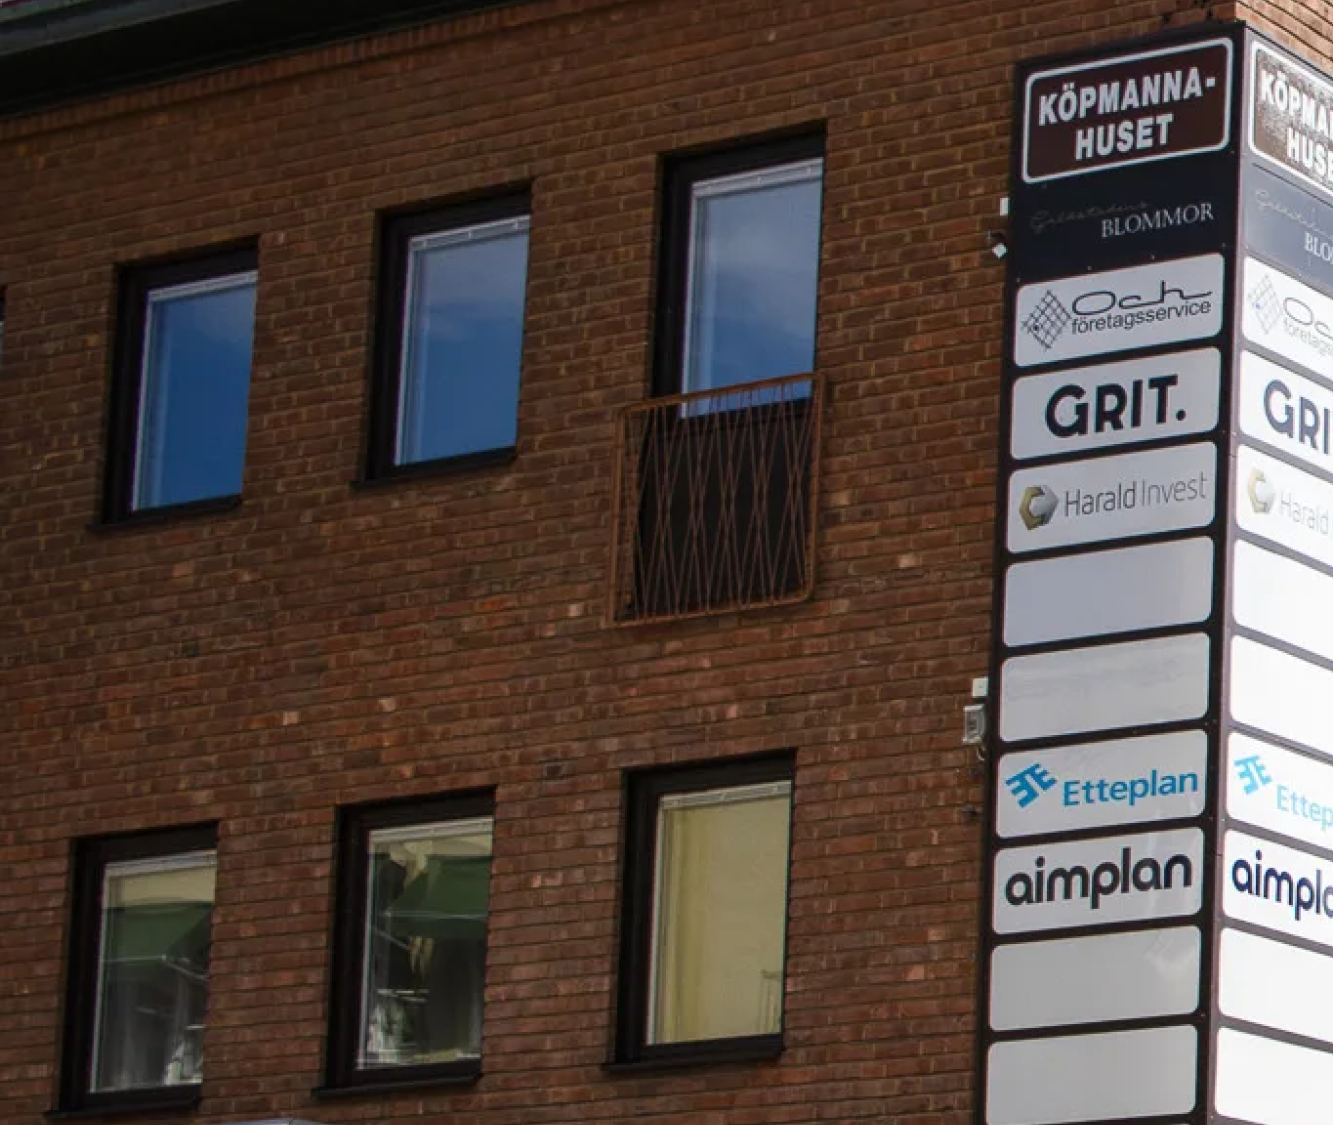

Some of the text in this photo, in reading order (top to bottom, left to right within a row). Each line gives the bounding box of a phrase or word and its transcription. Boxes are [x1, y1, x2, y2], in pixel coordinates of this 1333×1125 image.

[1038, 66, 1217, 127] KÖPMANNA-
[1075, 113, 1174, 161] HUSET
[1101, 201, 1215, 239] BLOMMOR
[1071, 281, 1212, 317] Och
[1071, 299, 1212, 335] företagsservice
[1044, 374, 1187, 438] GRIT.
[1063, 471, 1208, 517] Harald Invest
[1279, 495, 1330, 533] Harald
[1062, 769, 1199, 807] Etteplan
[1004, 847, 1193, 910] aimplan
